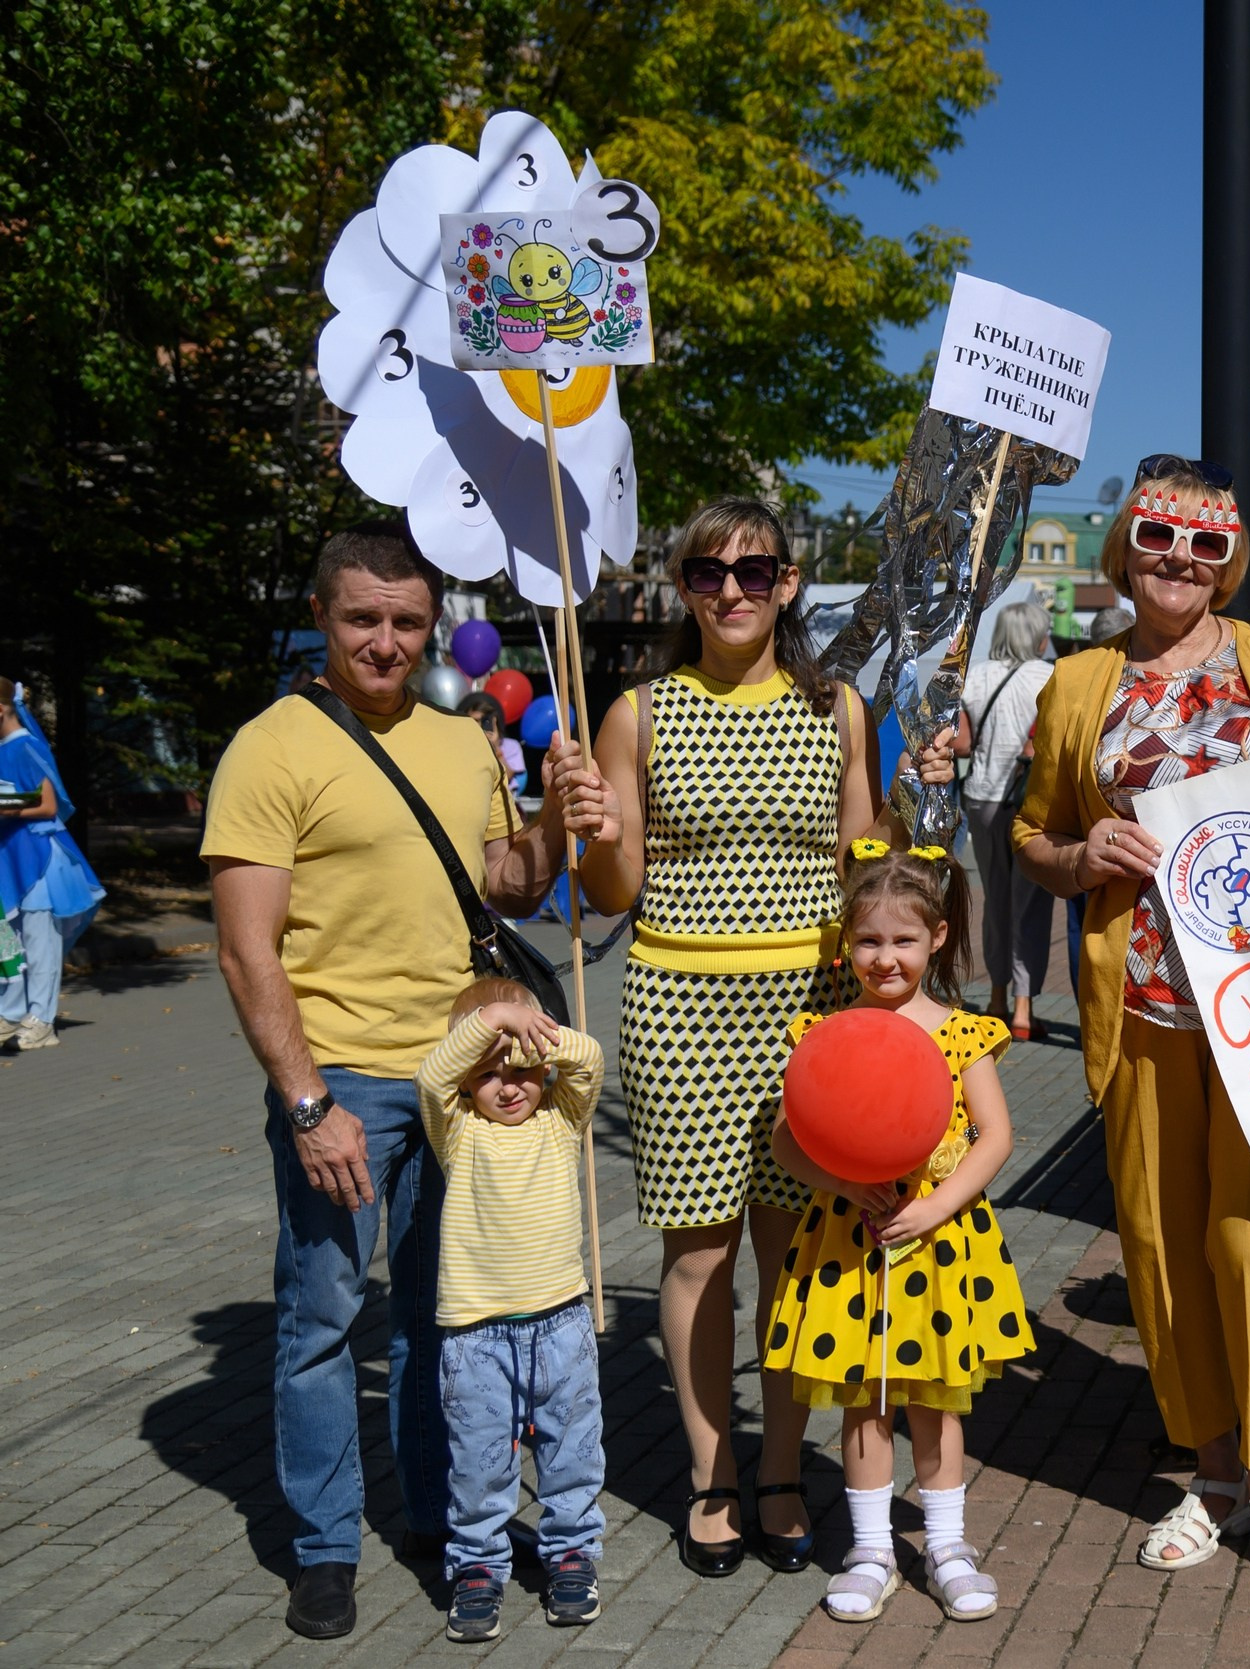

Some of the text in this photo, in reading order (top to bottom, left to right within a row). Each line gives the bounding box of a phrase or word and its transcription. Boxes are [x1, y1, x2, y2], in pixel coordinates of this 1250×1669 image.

[517, 153, 538, 187] 3
[587, 184, 656, 262] 3
[379, 328, 414, 381] 3
[973, 322, 1086, 378] КРЫЛАТЫЕ
[954, 345, 1090, 409] ТРУЖЕННИКИ
[984, 386, 1056, 426] ПЧЁЛЫ
[459, 481, 481, 508] 3
[614, 467, 625, 500] 3
[1144, 510, 1230, 532] Happy Birthday
